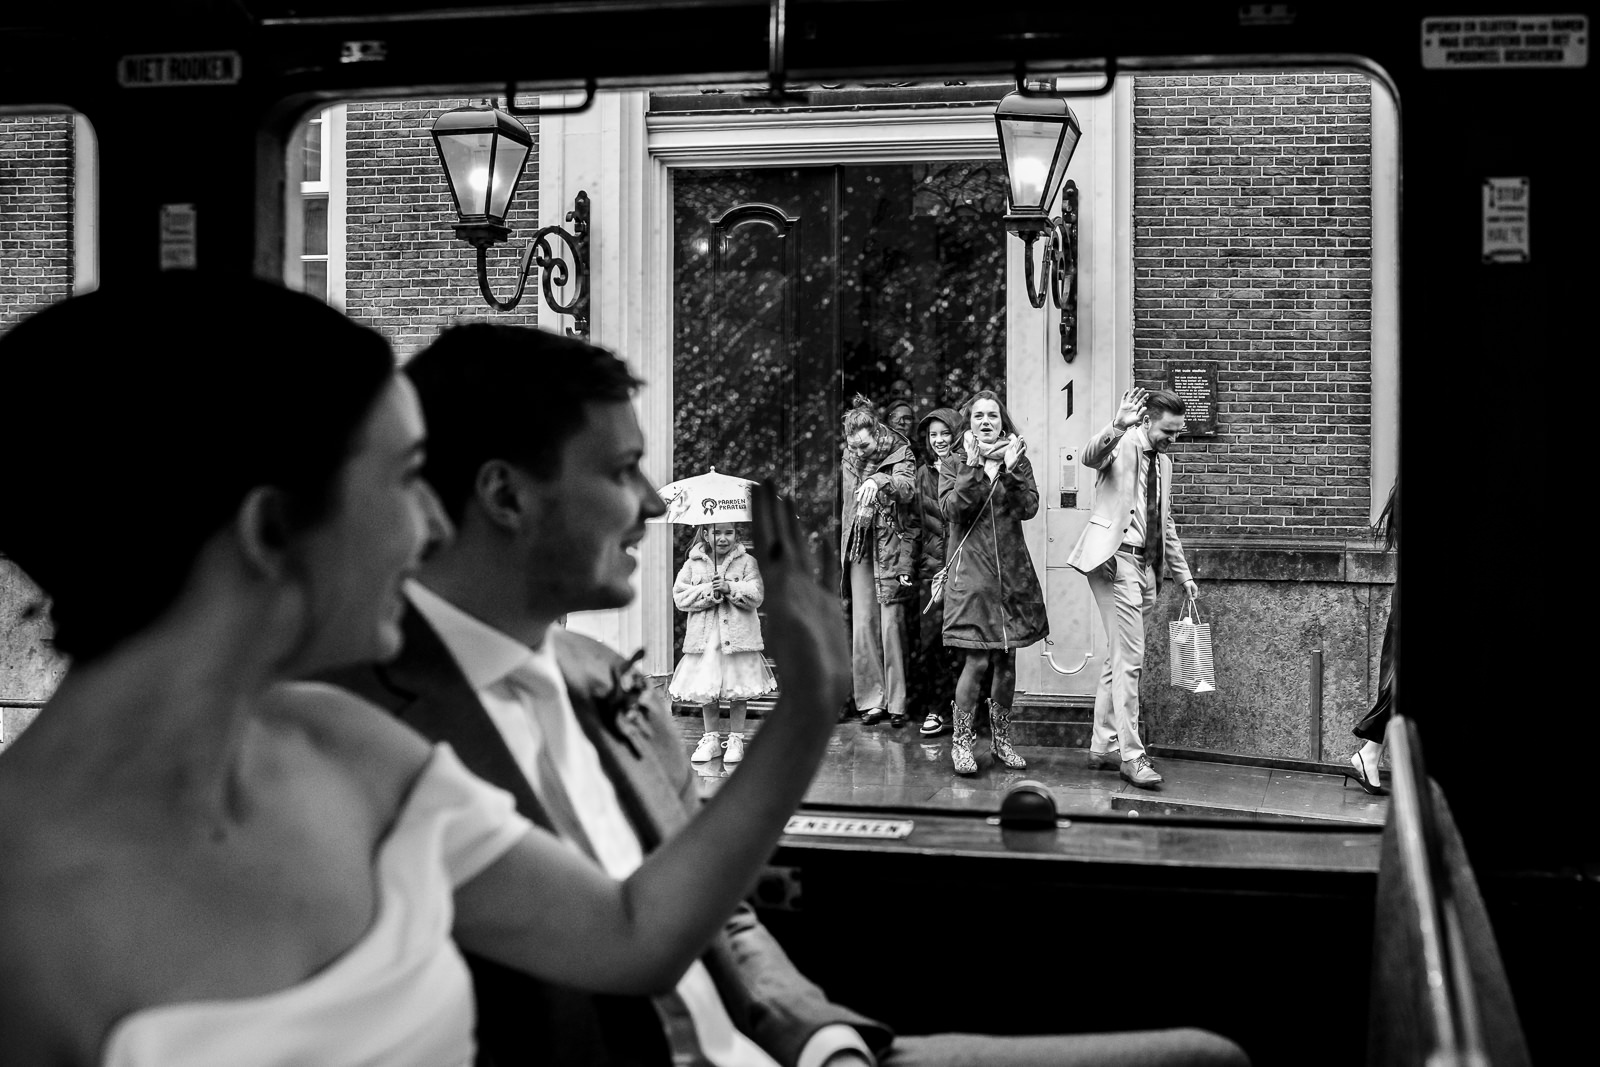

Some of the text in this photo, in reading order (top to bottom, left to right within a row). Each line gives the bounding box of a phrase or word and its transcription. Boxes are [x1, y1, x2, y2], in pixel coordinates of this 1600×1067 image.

[126, 56, 233, 82] NIET ROOKEN
[1061, 379, 1074, 421] 1
